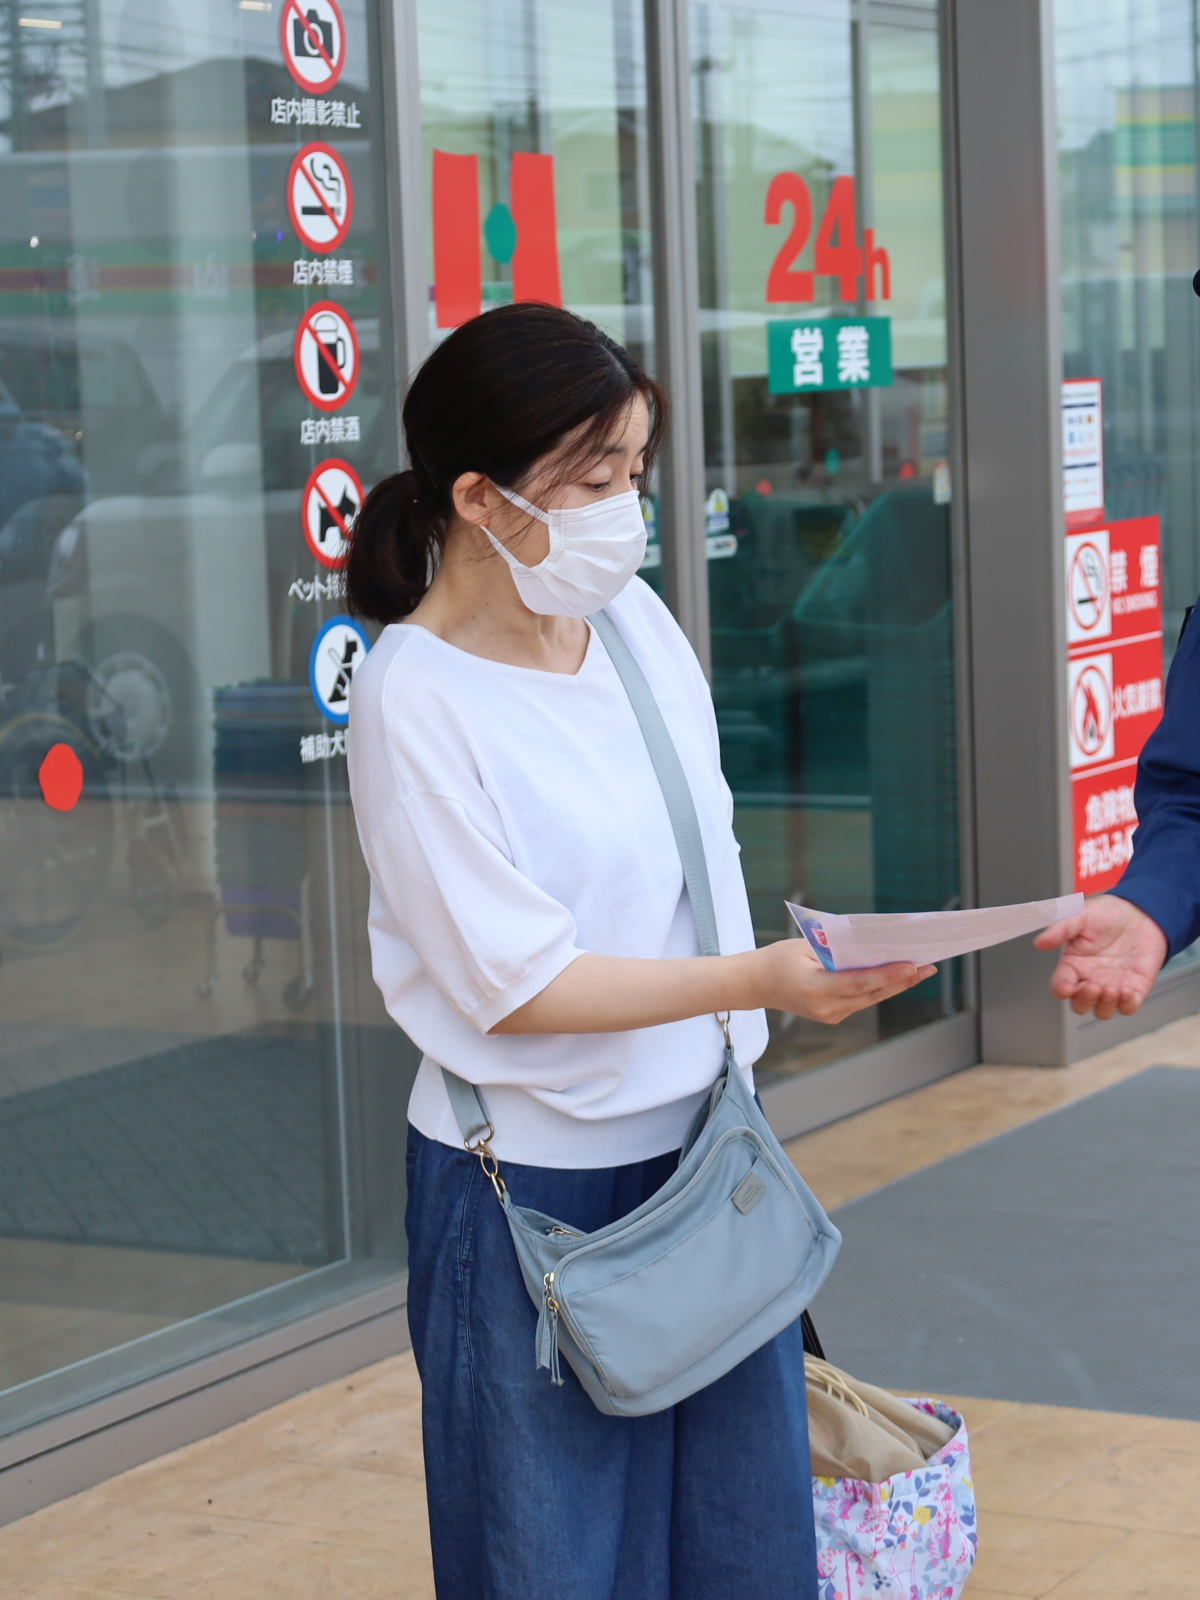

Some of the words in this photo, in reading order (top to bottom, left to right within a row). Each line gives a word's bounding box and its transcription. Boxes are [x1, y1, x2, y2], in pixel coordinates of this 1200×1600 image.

[270, 97, 362, 128] 店内撮影禁止
[765, 171, 891, 302] 24h
[292, 258, 354, 285] 店内禁煙
[790, 325, 871, 387] 営業
[300, 416, 361, 445] 店内禁酒
[299, 727, 350, 764] 補助犬
